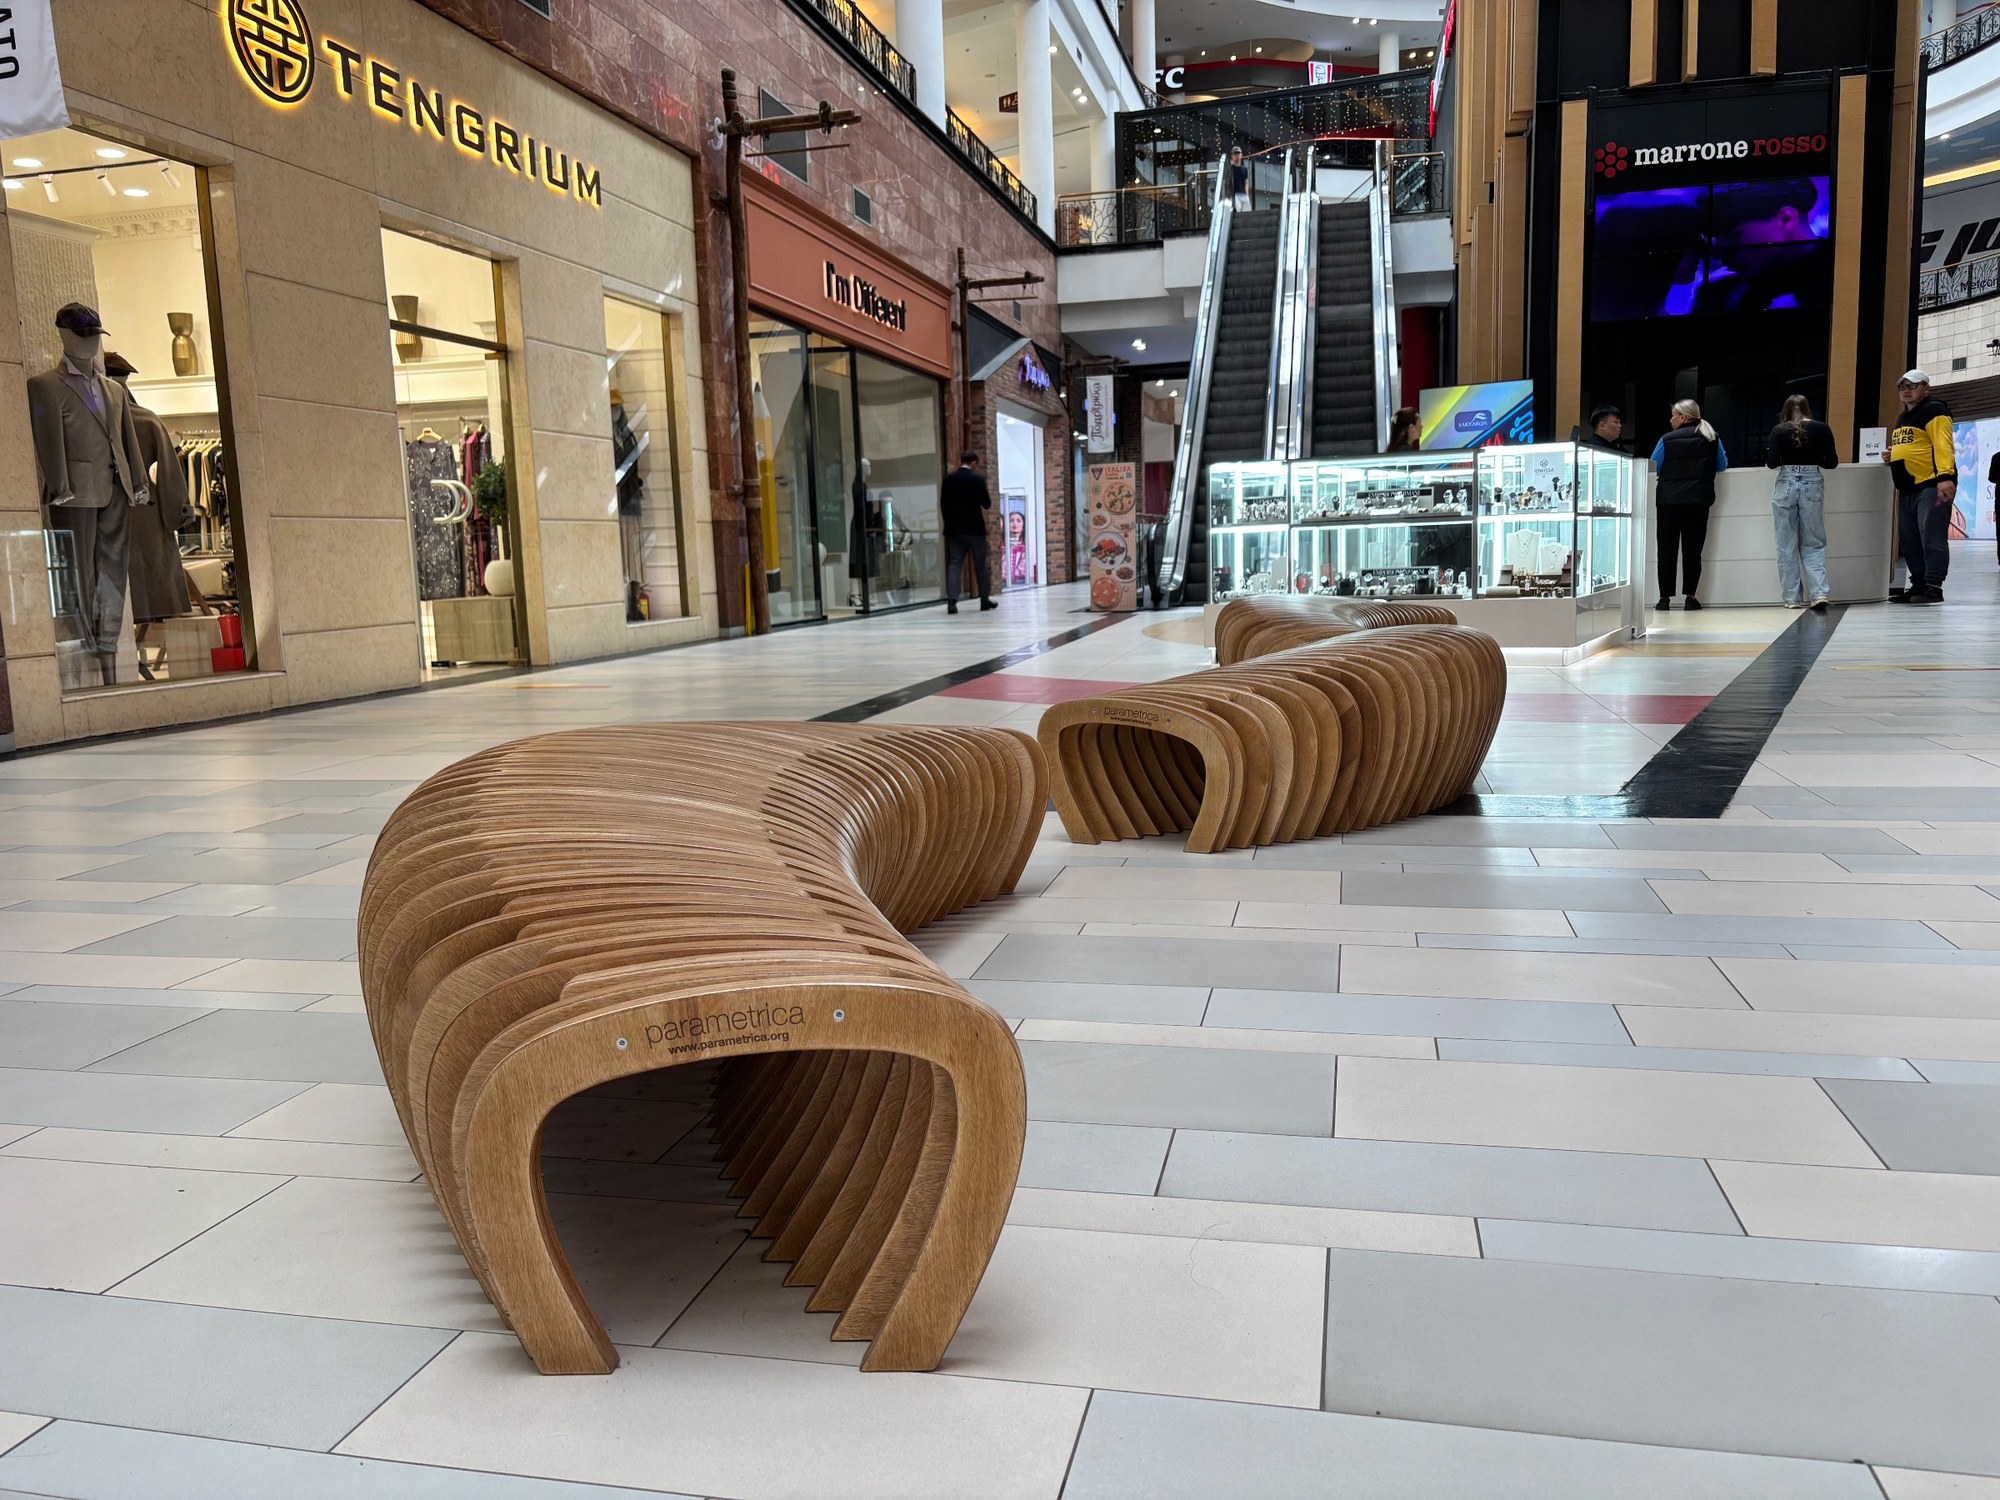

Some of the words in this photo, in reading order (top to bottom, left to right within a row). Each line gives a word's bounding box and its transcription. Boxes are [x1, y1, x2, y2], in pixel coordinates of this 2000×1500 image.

[1155, 66, 1185, 89] FC
[325, 40, 602, 206] TENGRIUM
[1635, 140, 1748, 166] marrone
[1752, 134, 1827, 157] rosso
[823, 260, 850, 307] I'm
[850, 272, 906, 332] Different
[1091, 382, 1105, 442] Подружка
[1104, 706, 1159, 721] parametrica
[644, 1003, 807, 1049] parametrica
[668, 1030, 790, 1056] www.parametrica.org
